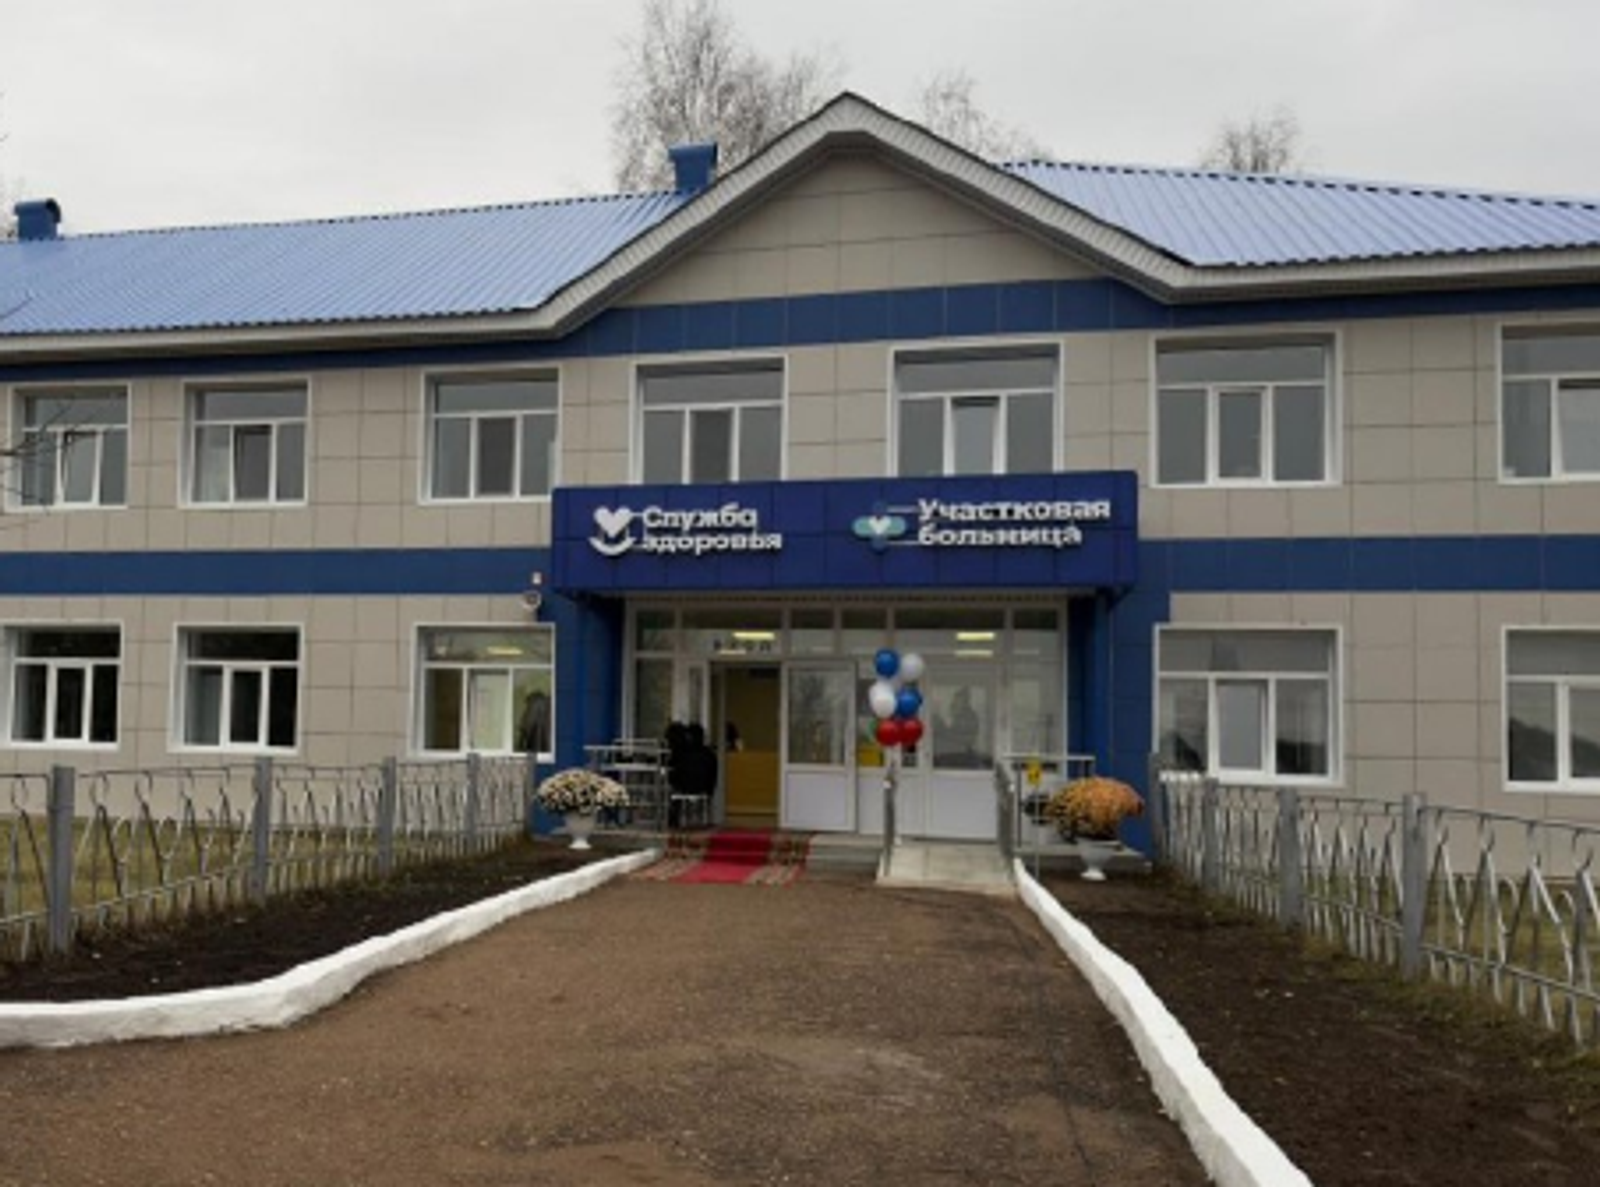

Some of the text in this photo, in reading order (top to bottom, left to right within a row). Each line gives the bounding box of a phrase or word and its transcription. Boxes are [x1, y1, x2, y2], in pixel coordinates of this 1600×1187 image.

[642, 502, 757, 531] Служба
[918, 498, 1111, 521] Участковая
[918, 523, 1082, 547] больница
